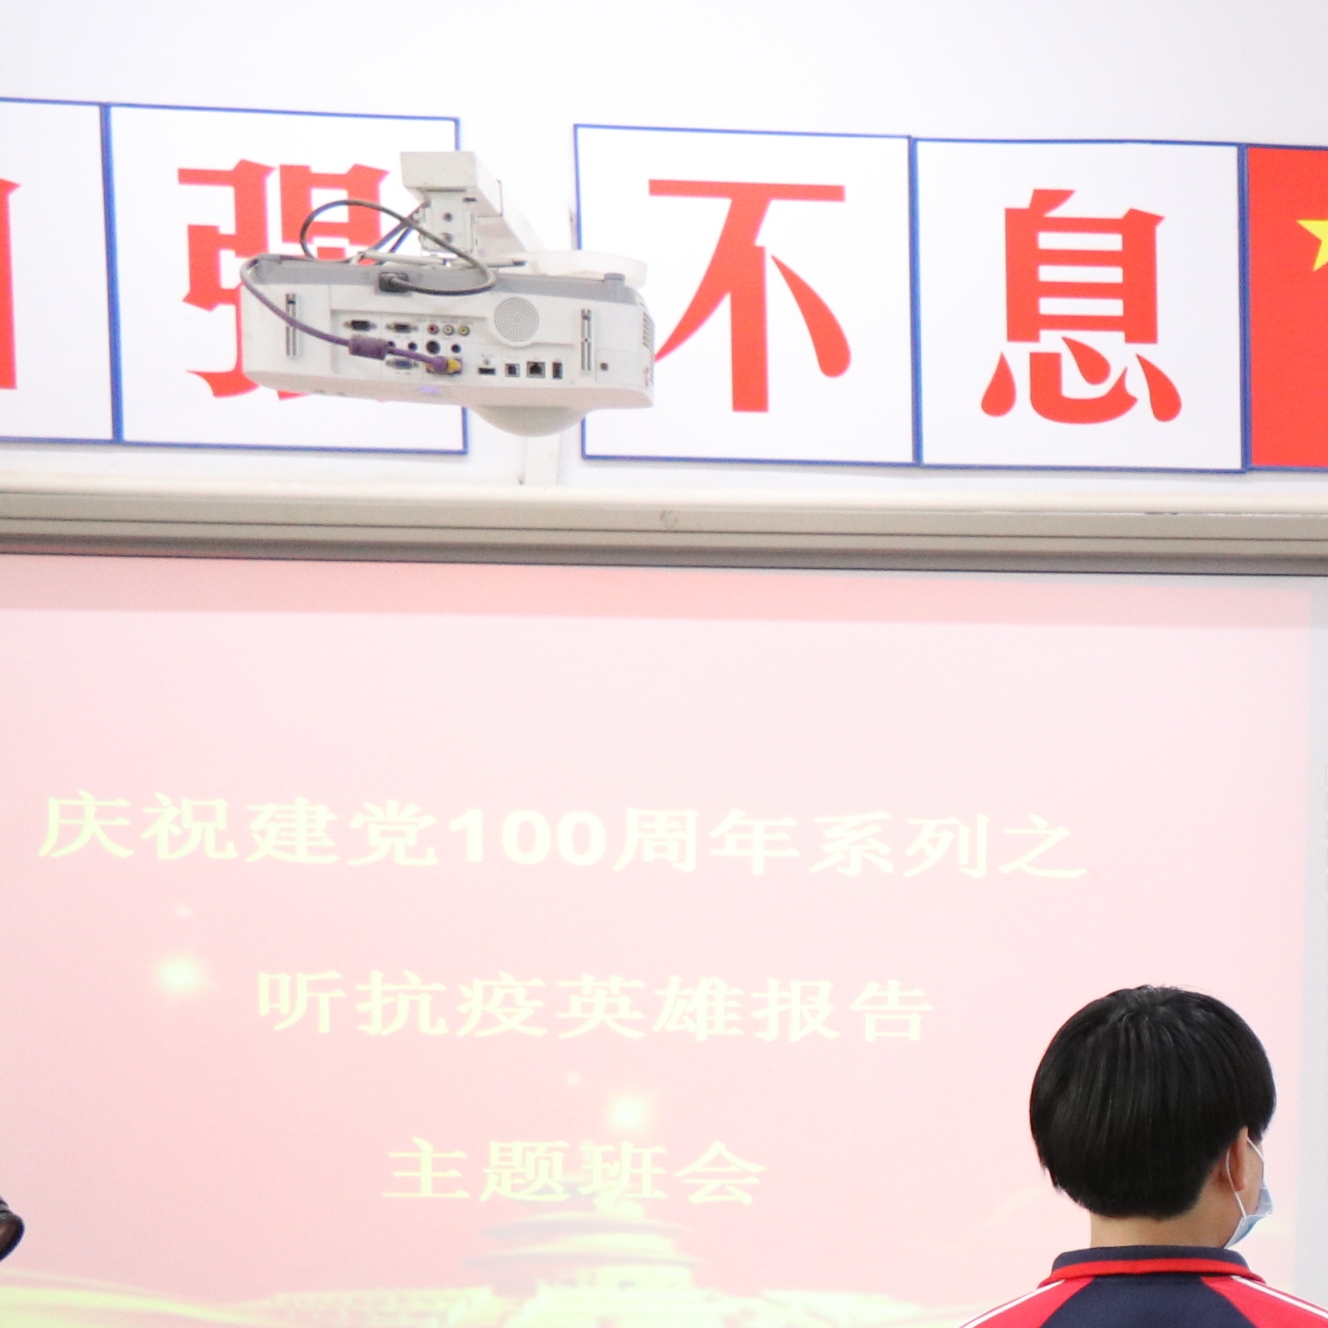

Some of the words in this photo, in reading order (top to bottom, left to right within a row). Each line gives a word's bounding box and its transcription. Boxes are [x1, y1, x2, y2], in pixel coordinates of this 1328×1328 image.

[37, 789, 1087, 879] 庆祝建党100周年系列之
[257, 970, 935, 1043] 听抗疫英雄报告
[381, 1137, 767, 1205] 主题班会
